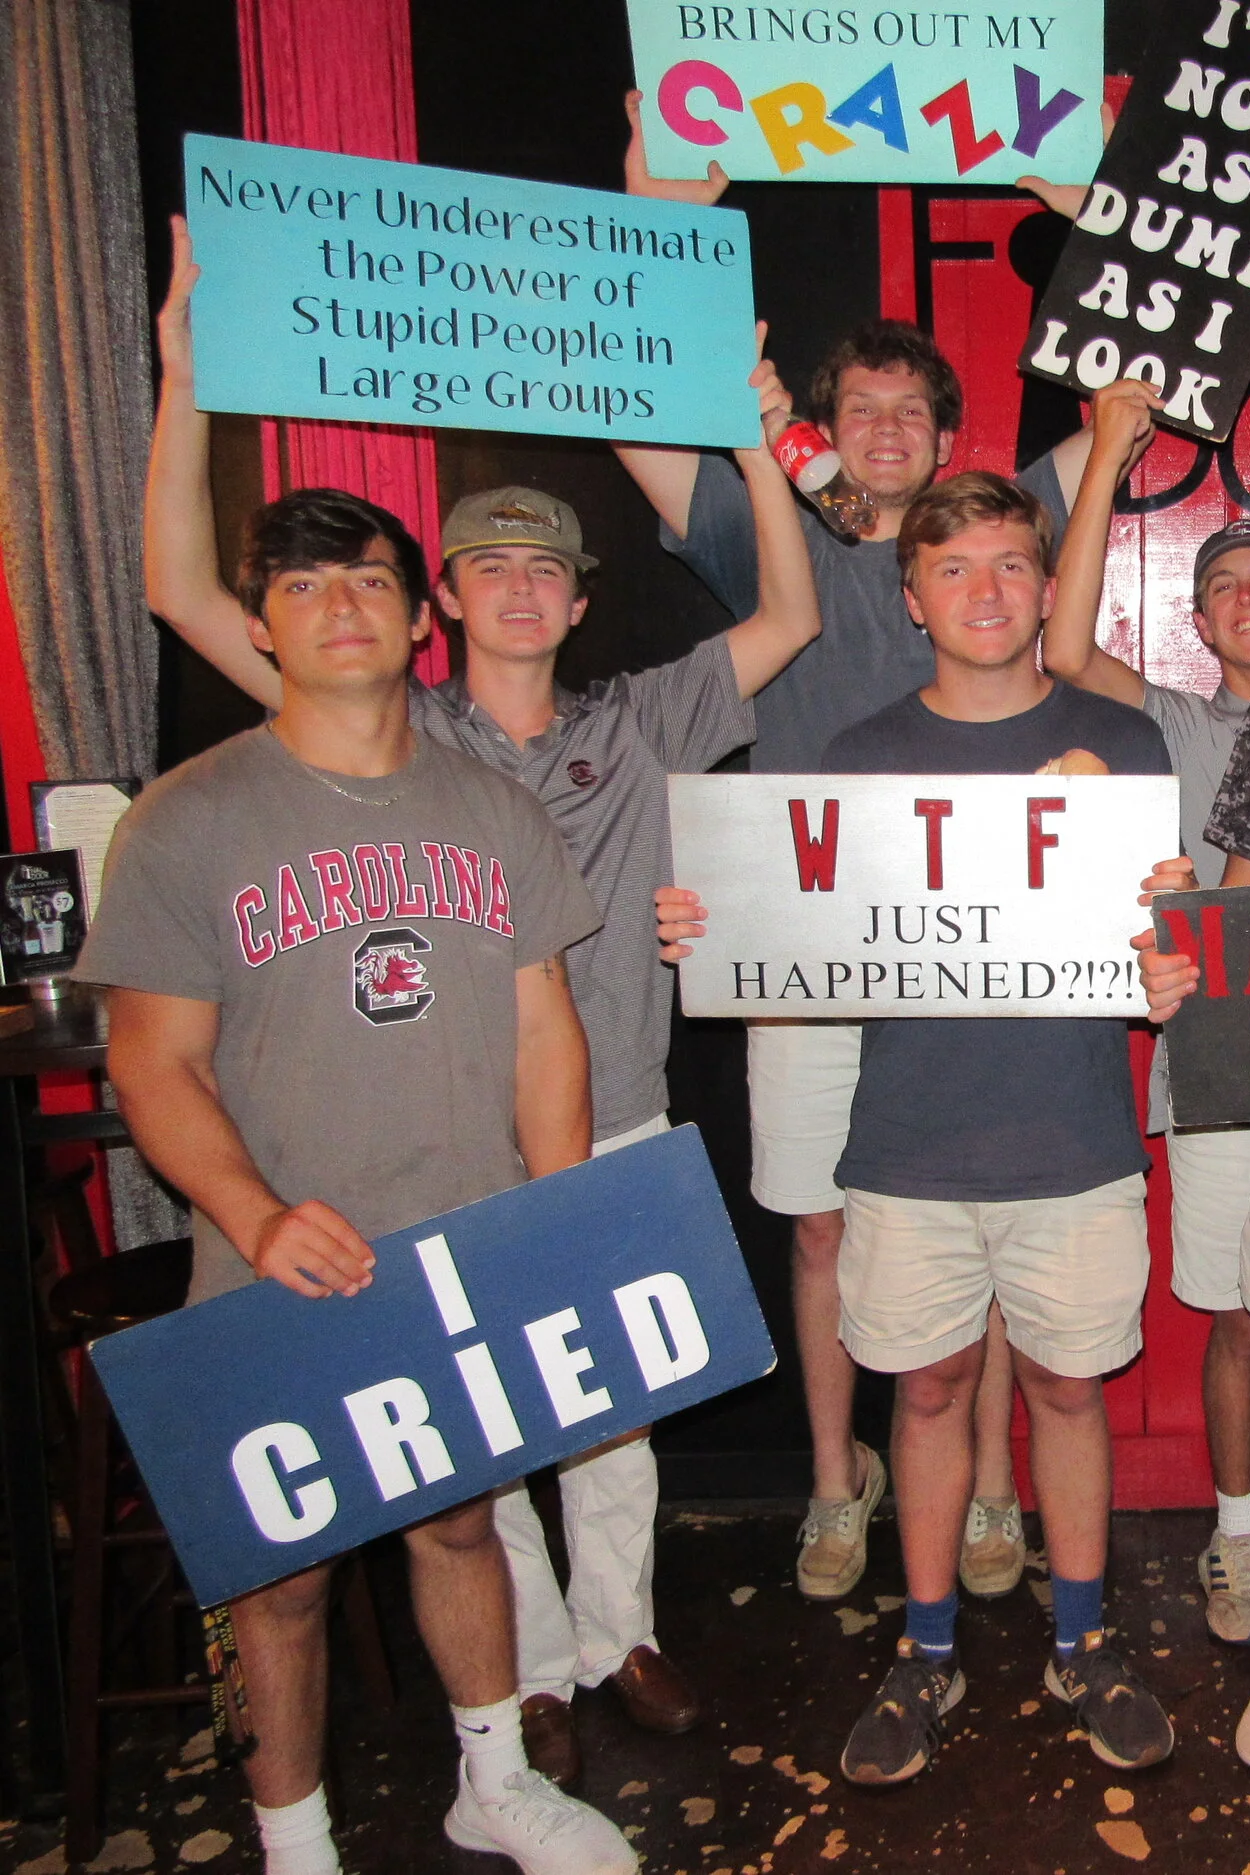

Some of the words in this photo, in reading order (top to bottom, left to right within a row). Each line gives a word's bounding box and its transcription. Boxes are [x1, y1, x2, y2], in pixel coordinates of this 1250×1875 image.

[677, 5, 859, 45] BRINGS
[874, 11, 970, 49] OUT
[985, 16, 1057, 50] MY
[657, 59, 1085, 177] CRAZY
[200, 165, 361, 221] Never
[375, 191, 737, 268] Underestimate
[318, 238, 405, 285] the
[416, 250, 579, 304] Power
[593, 271, 645, 310] of
[1077, 262, 1181, 333] AS
[1194, 300, 1233, 354] I
[292, 295, 460, 354] Stupid
[471, 311, 625, 368] People
[636, 327, 674, 366] in
[1030, 319, 1223, 432] LOOK
[318, 357, 472, 414] Large
[486, 369, 656, 426] Groups
[233, 841, 516, 969] CAROLINA
[863, 905, 1001, 945] JUST
[730, 960, 1135, 1001] HAPPENED?!?!
[415, 1234, 477, 1336] I
[231, 1270, 711, 1544] CRIED
